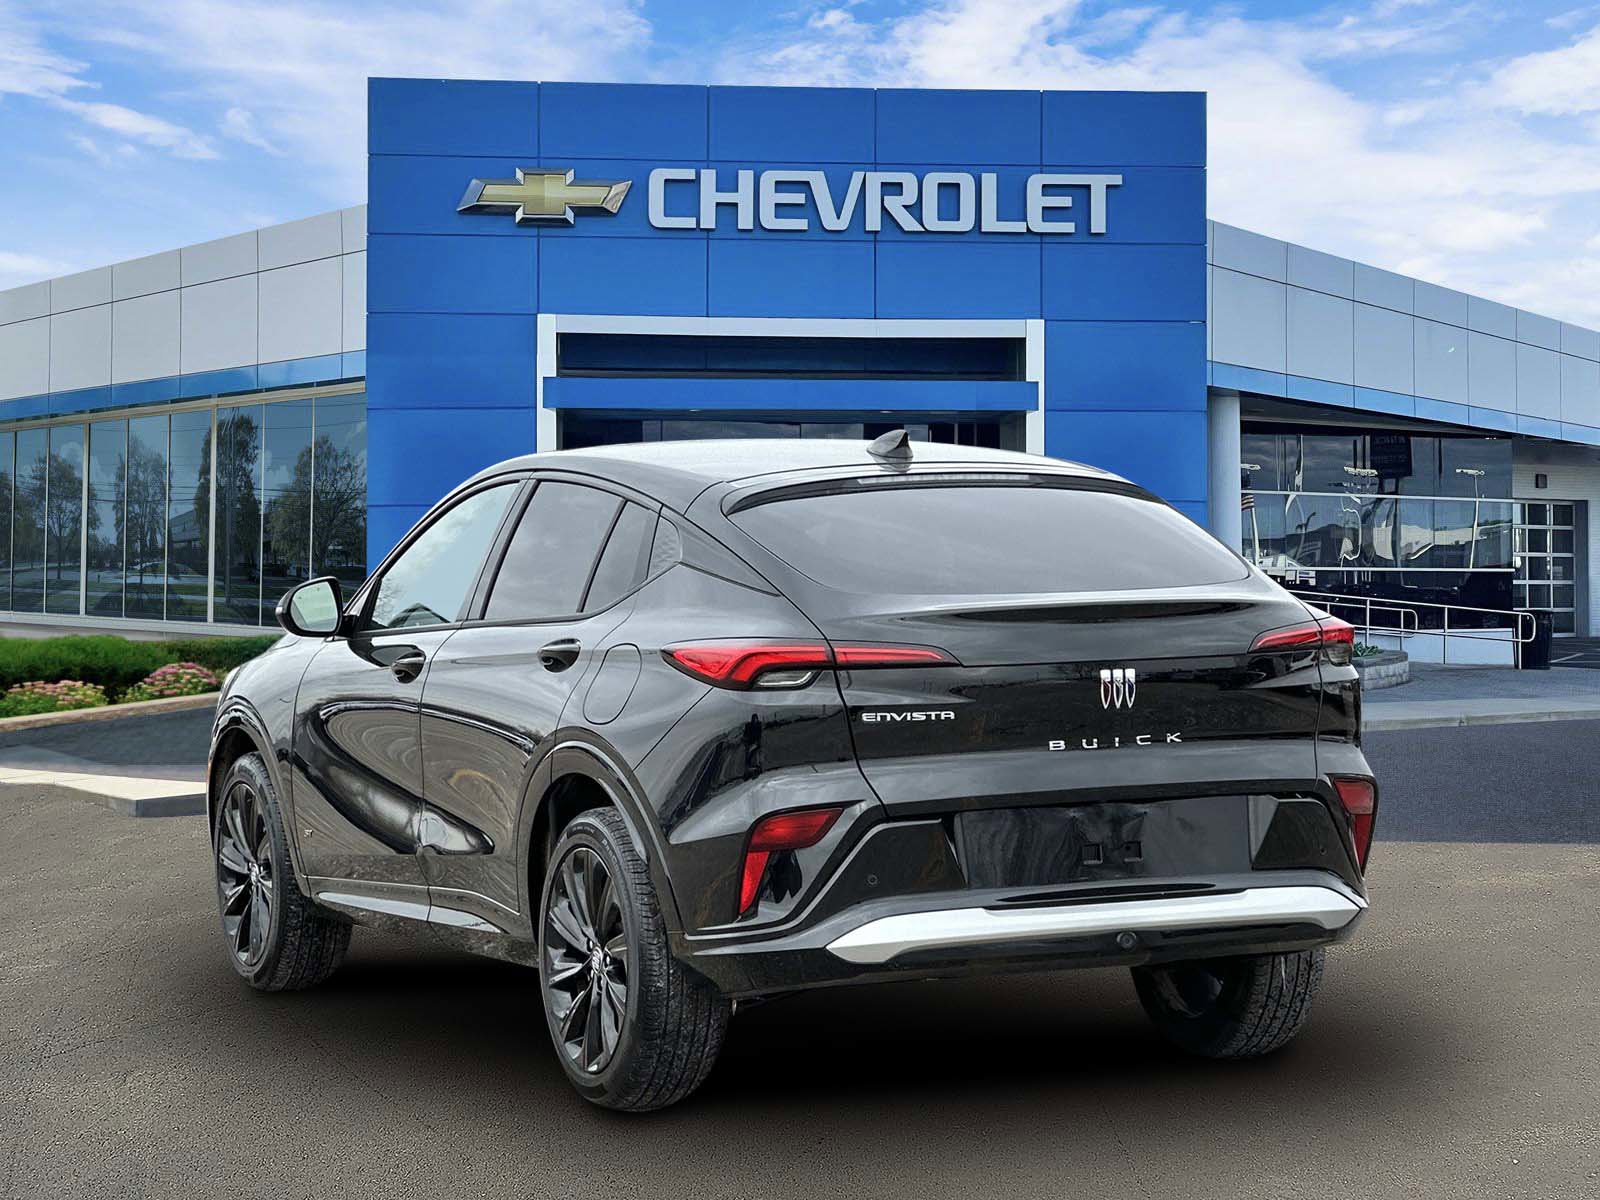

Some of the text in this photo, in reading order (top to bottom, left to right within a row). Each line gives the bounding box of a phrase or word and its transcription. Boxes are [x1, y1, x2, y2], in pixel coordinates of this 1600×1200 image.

[648, 167, 1123, 235] CHEVROLET
[861, 710, 955, 722] ENVISTA
[1048, 731, 1183, 751] BUICK
